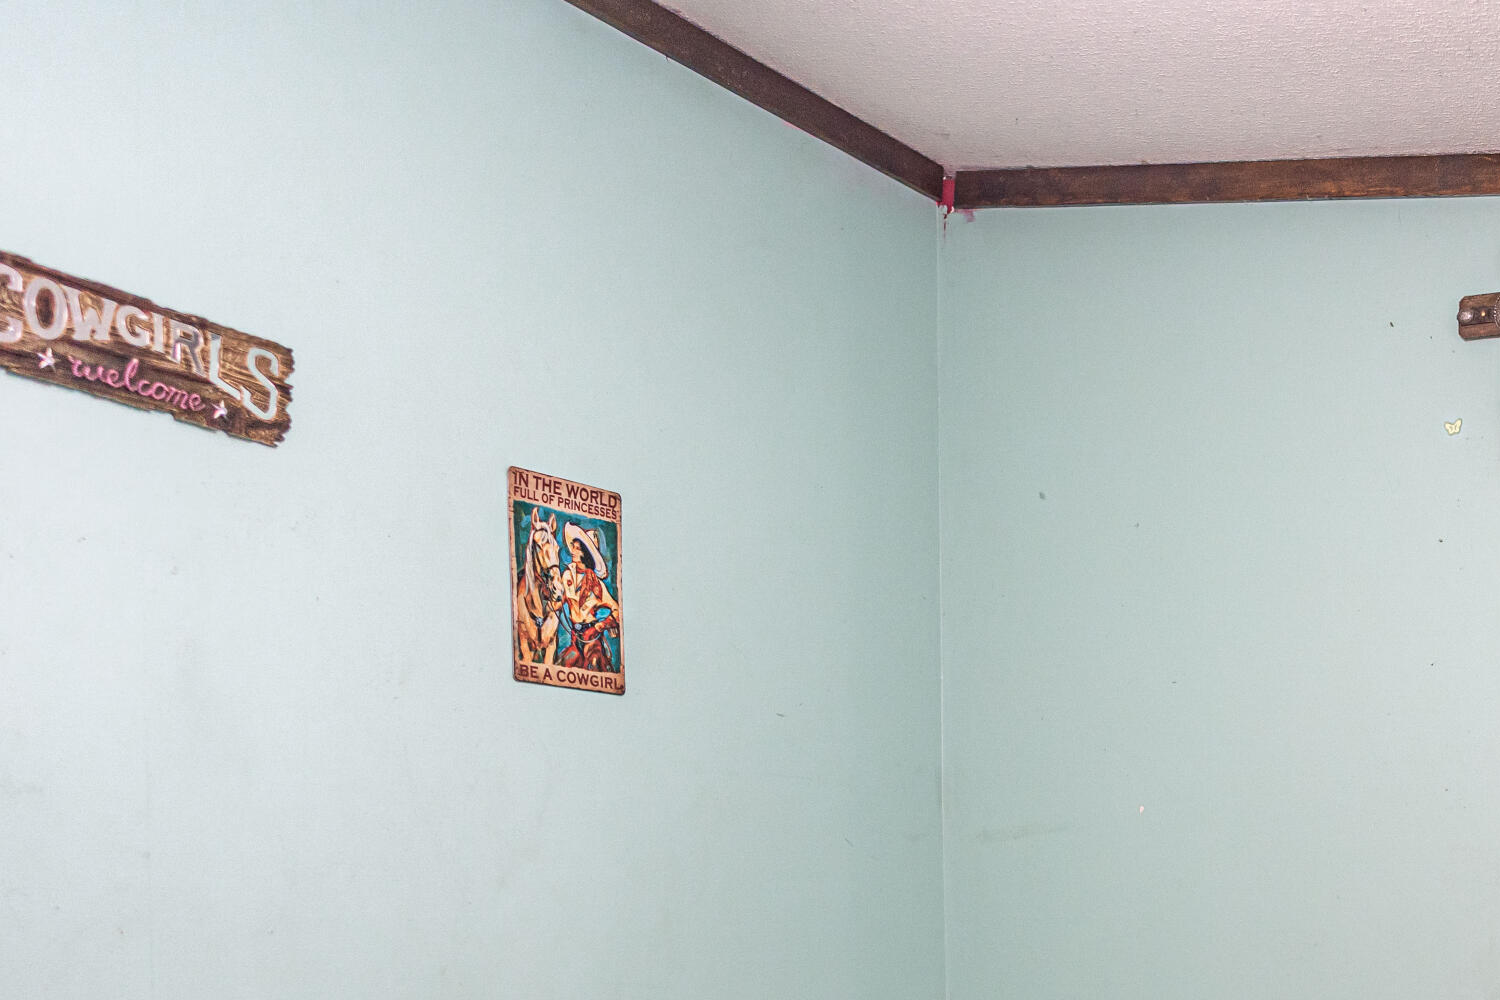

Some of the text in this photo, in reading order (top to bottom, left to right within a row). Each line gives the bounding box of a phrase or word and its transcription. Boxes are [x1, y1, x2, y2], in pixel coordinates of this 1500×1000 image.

[68, 358, 206, 412] welcome
[513, 471, 617, 508] IN THE WORLD
[514, 486, 618, 520] FULL OF PRINCESSES
[520, 664, 623, 690] BE A COWGIRL
